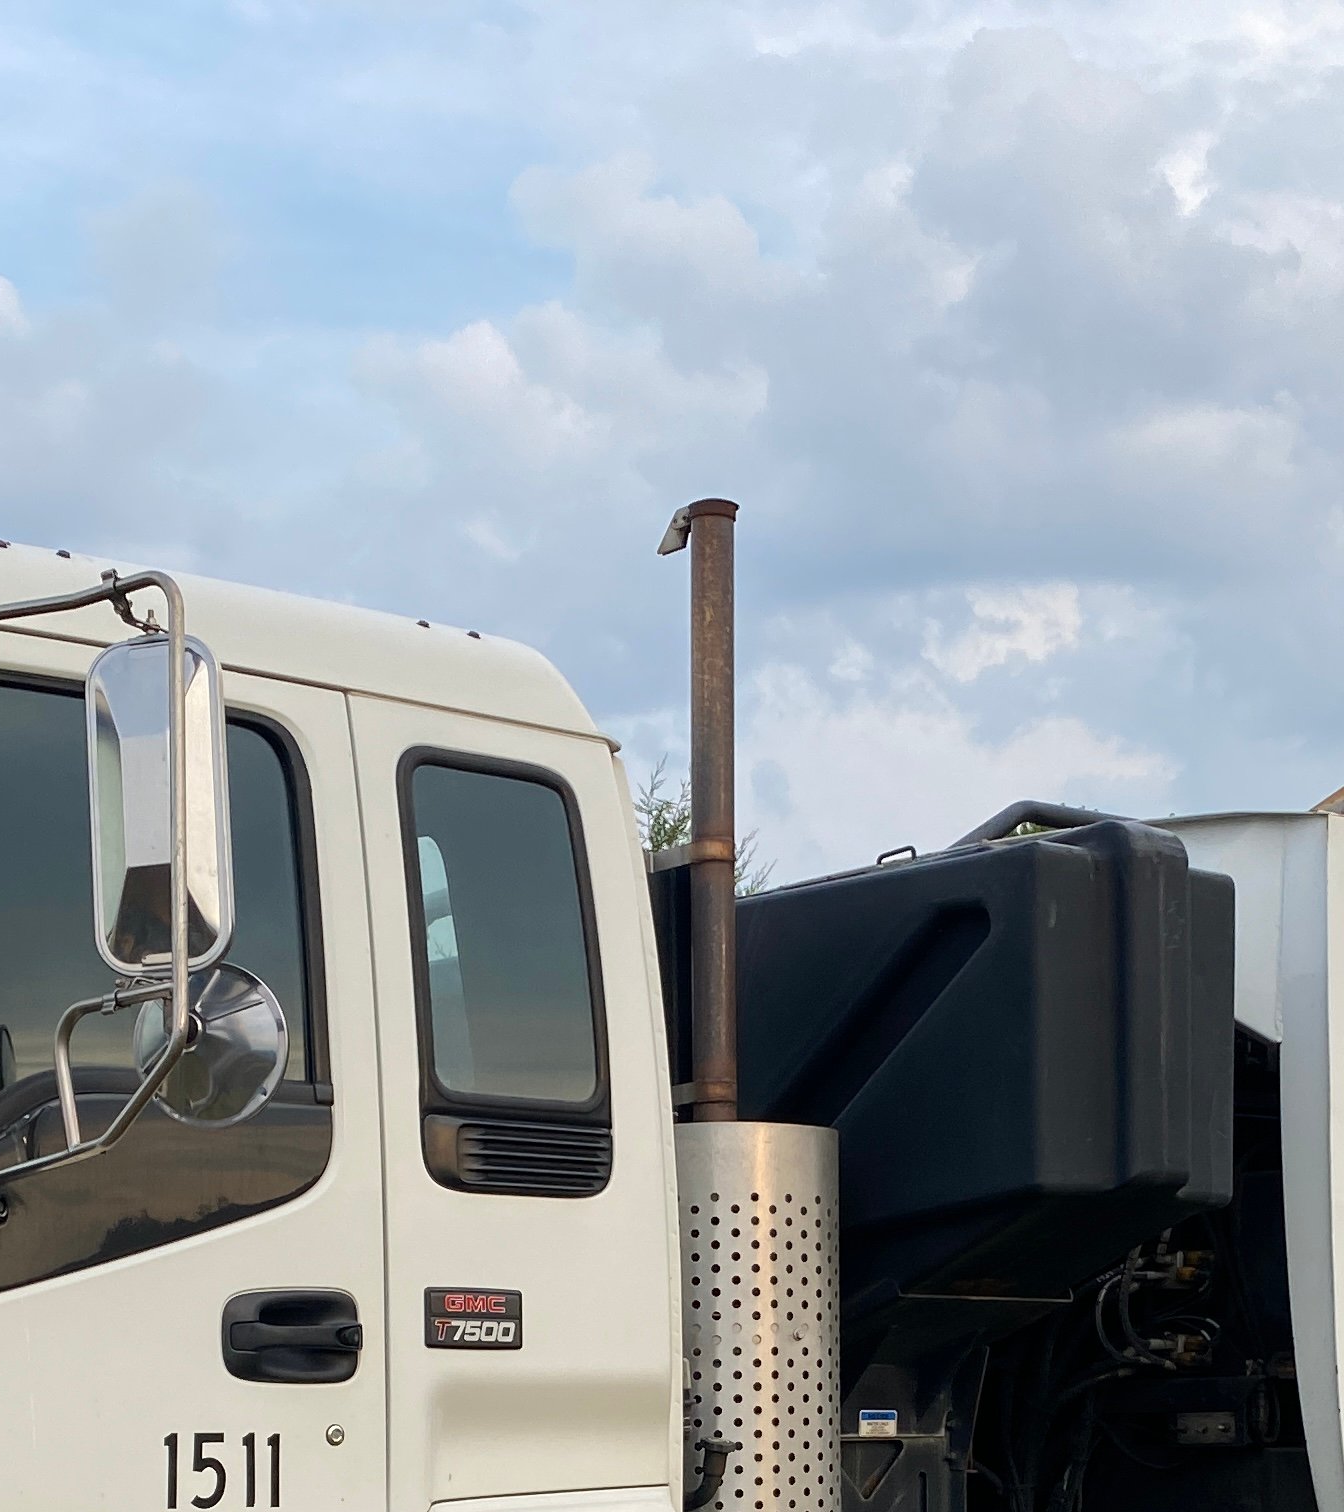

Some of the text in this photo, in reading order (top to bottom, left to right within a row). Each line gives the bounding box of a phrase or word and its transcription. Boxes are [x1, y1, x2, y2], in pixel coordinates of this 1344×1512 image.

[444, 1294, 506, 1314] GMC
[434, 1319, 516, 1342] T7500
[163, 1432, 281, 1509] 1511
